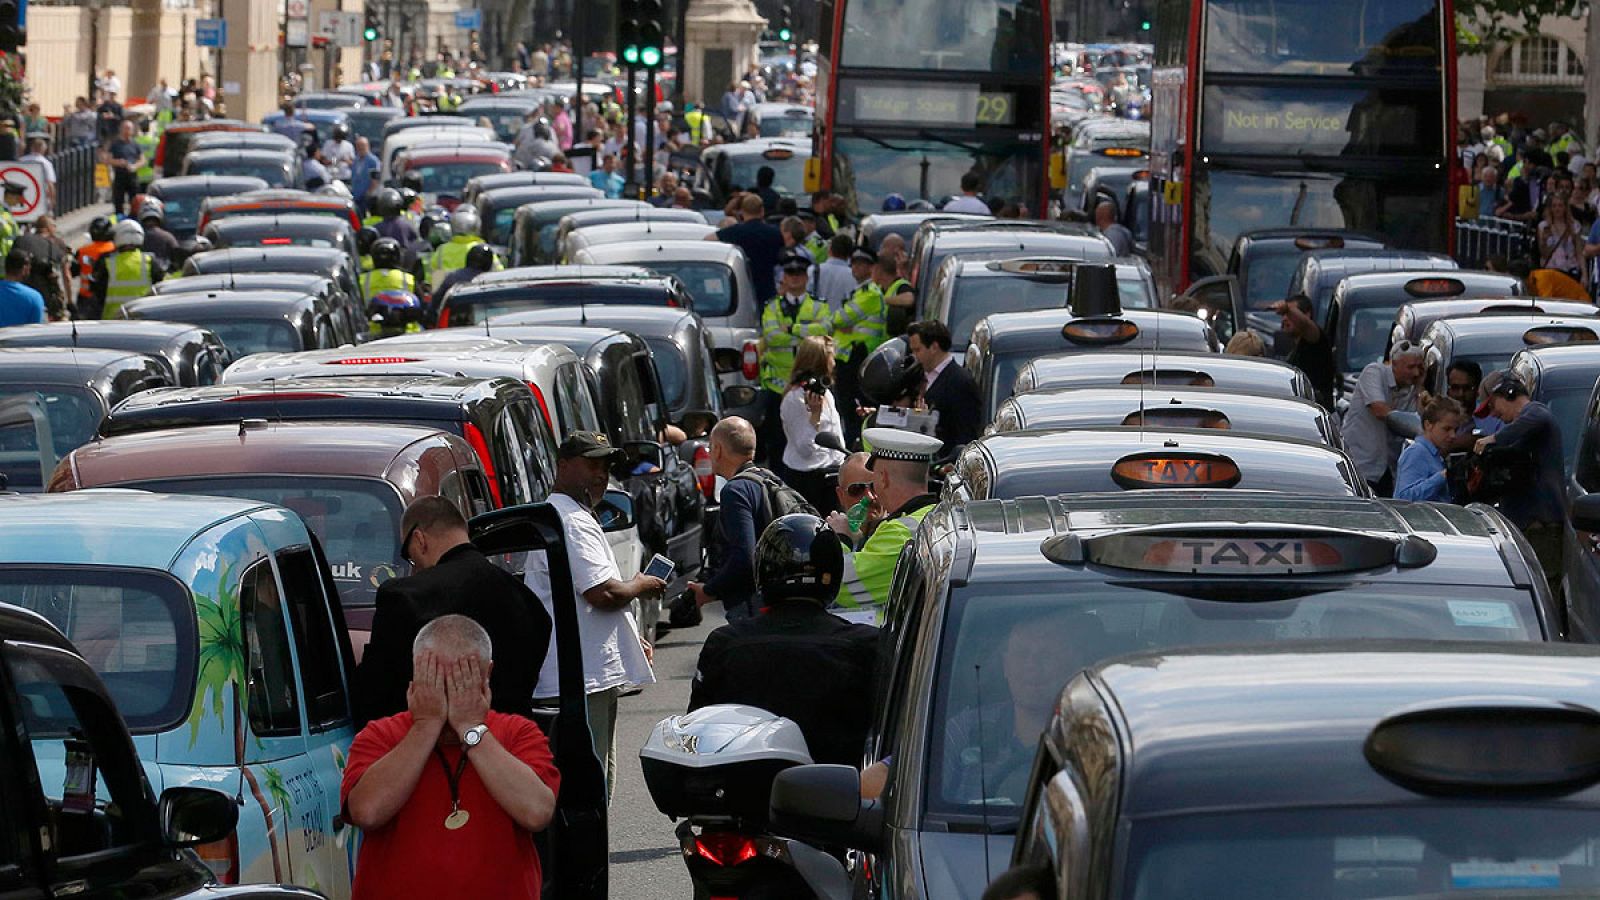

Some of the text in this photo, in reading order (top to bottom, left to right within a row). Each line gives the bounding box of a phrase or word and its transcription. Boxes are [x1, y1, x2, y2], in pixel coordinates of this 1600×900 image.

[977, 96, 1008, 123] 29
[1227, 110, 1341, 131] Not in Service
[1143, 461, 1212, 481] TAXI
[1182, 542, 1303, 565] TAXI
